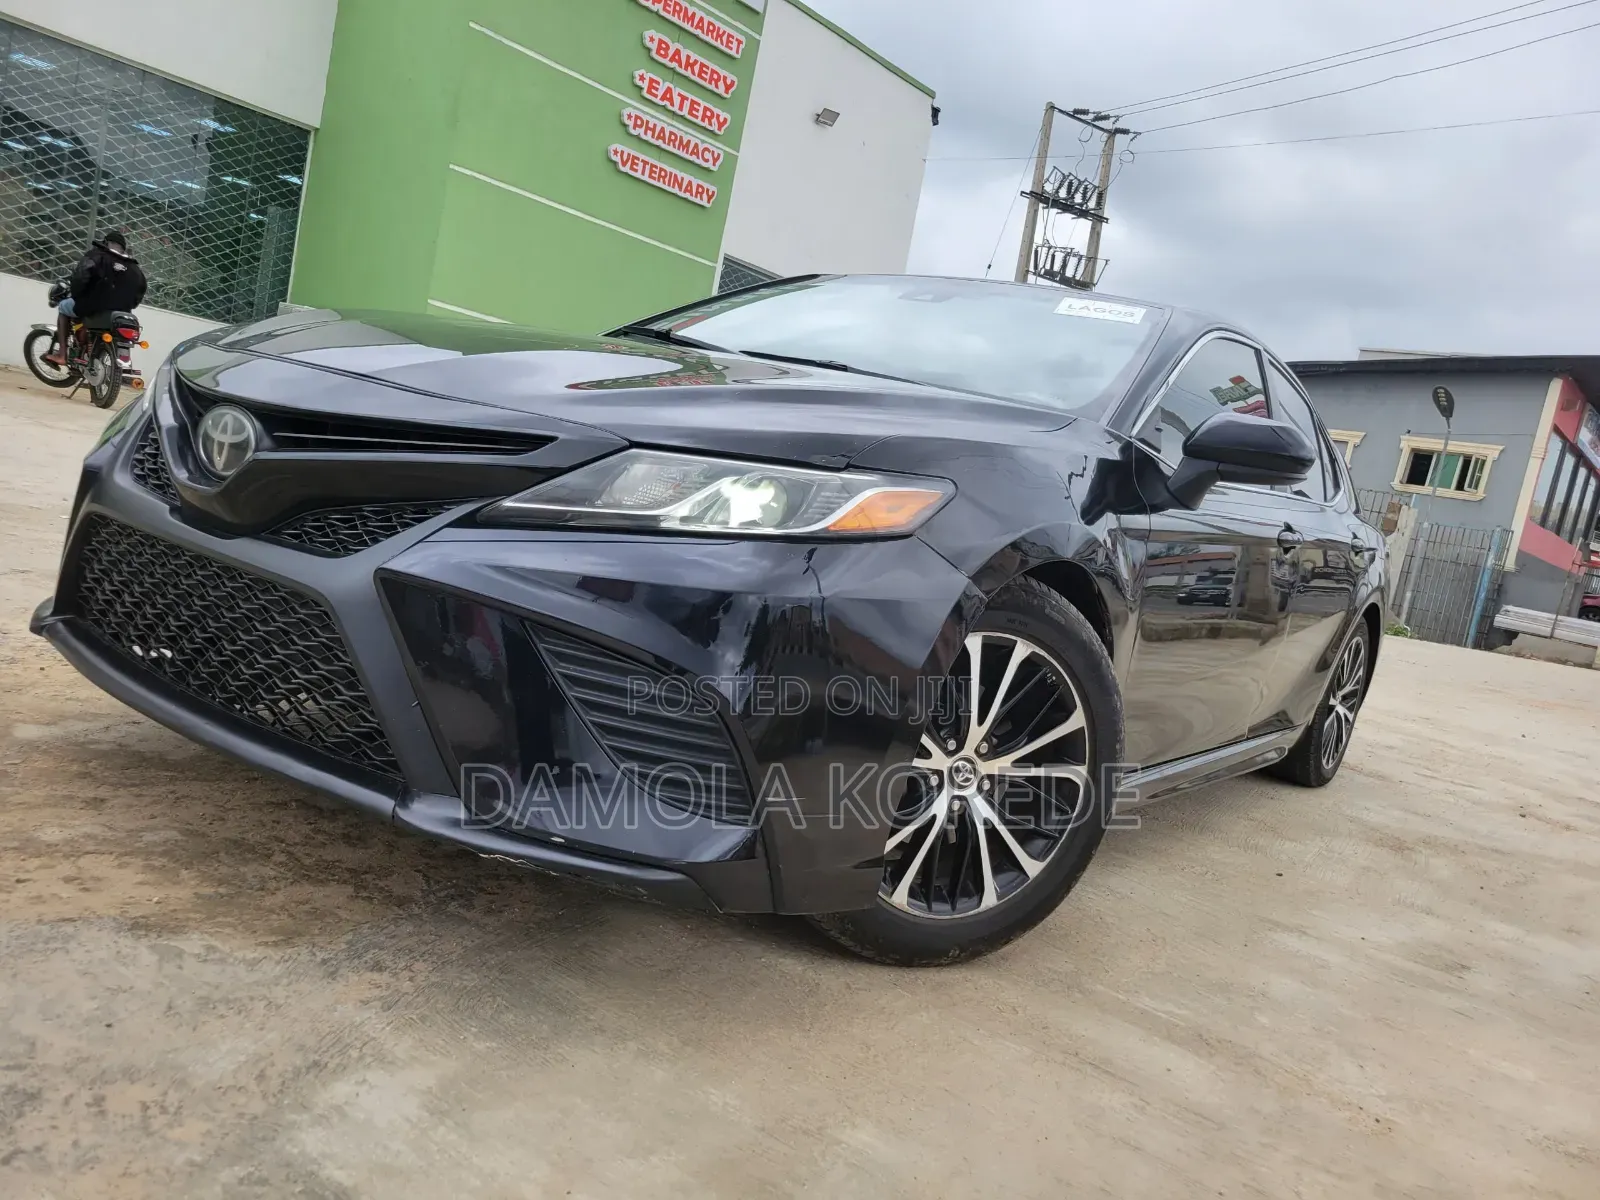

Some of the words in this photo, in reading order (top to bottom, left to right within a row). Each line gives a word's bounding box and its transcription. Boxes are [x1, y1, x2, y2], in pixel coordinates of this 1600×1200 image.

[655, 38, 736, 95] BAKERY
[646, 76, 728, 132] EATERY
[632, 114, 721, 167] PHARMACY
[619, 150, 716, 204] VETERINARY
[1067, 303, 1135, 318] LAGOS
